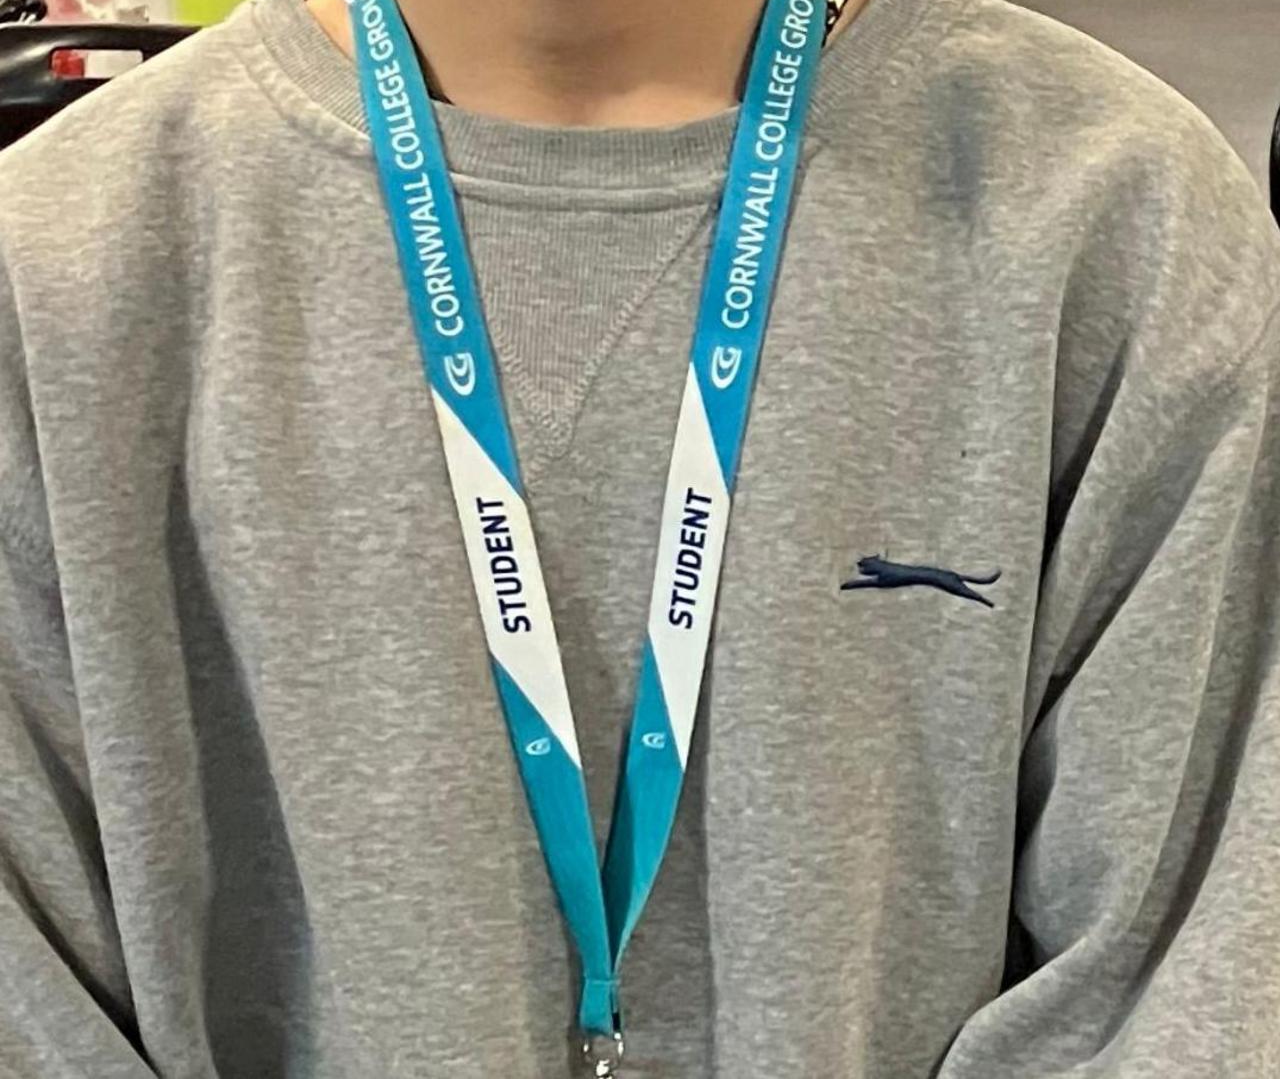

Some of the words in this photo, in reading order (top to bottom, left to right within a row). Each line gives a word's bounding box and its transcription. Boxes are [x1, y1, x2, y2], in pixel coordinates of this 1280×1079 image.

[374, 60, 426, 170] COLLEGE
[403, 172, 465, 336] CORNWALL
[721, 167, 778, 329] CORNWALL
[755, 50, 803, 161] COLLEGE
[476, 497, 531, 633] STUDENT
[668, 487, 713, 629] STUDENT
